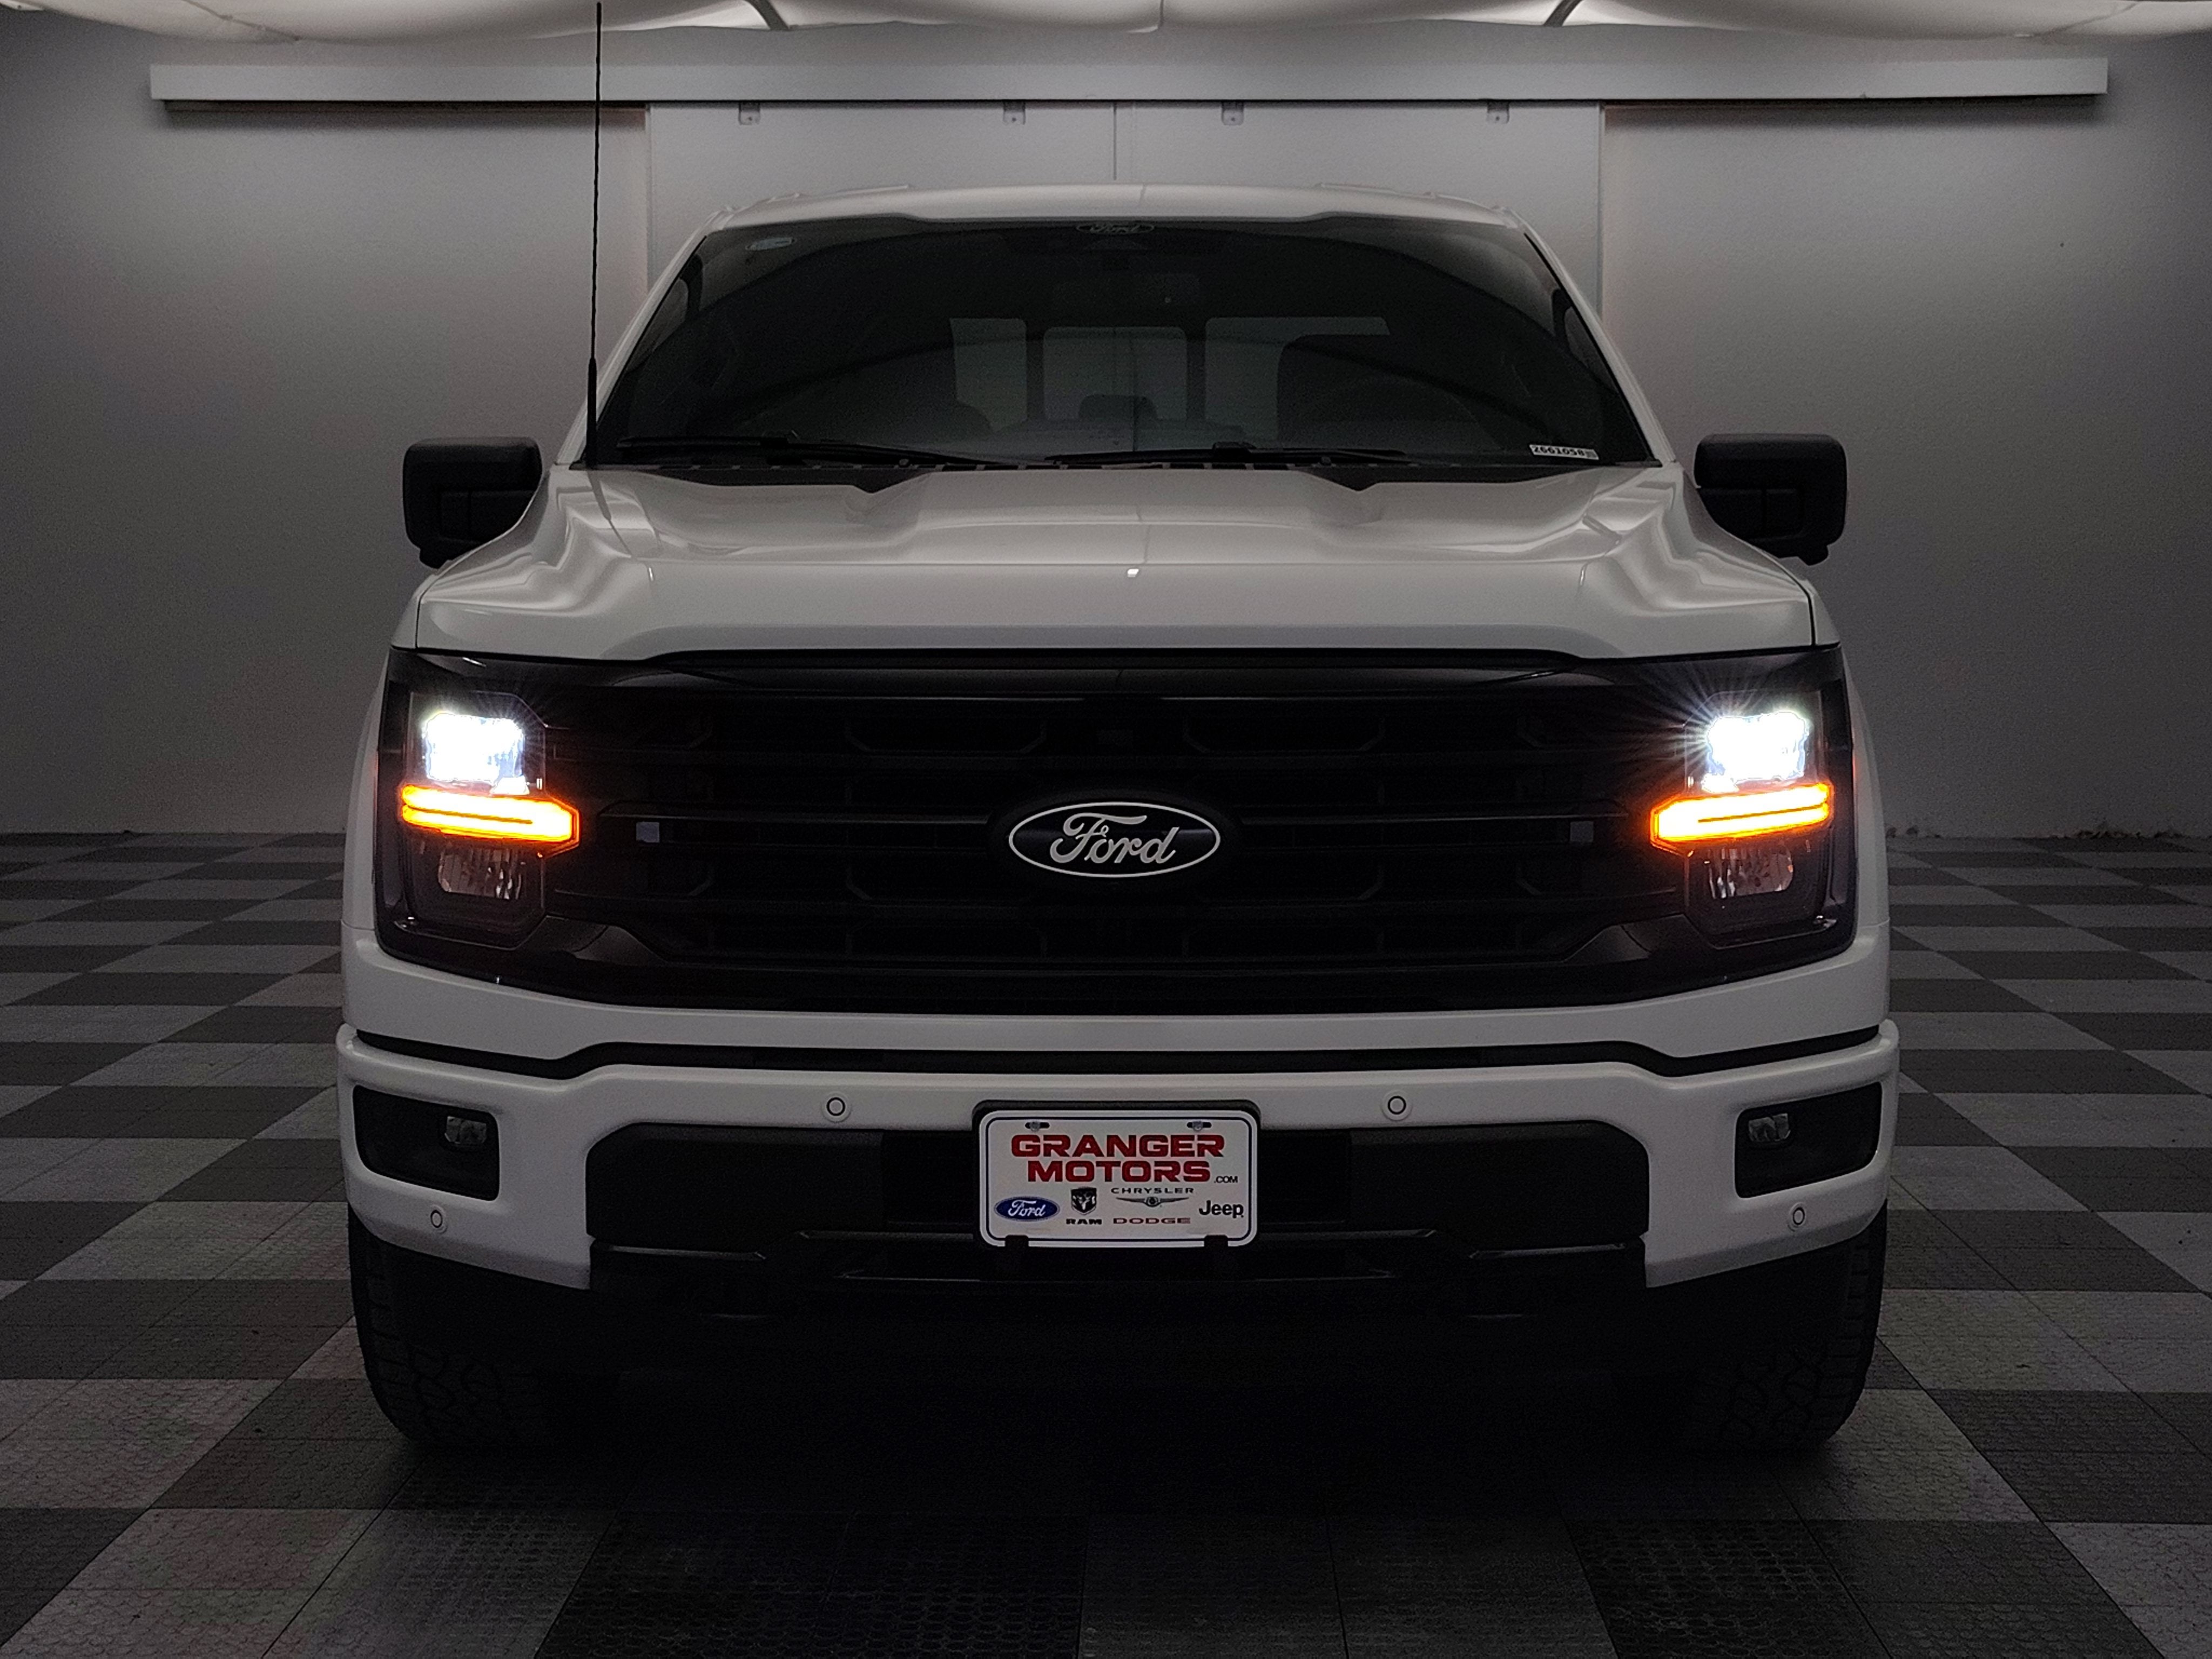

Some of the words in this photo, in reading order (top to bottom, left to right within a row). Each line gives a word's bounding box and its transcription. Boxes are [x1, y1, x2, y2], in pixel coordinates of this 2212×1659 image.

[1050, 813, 1179, 864] Ford
[1011, 1135, 1225, 1157] GRANGER
[1028, 1161, 1211, 1182] MOTORS
[1213, 1175, 1238, 1184] .COM
[1008, 1199, 1046, 1217] Ford
[1199, 1200, 1244, 1218] Jeep
